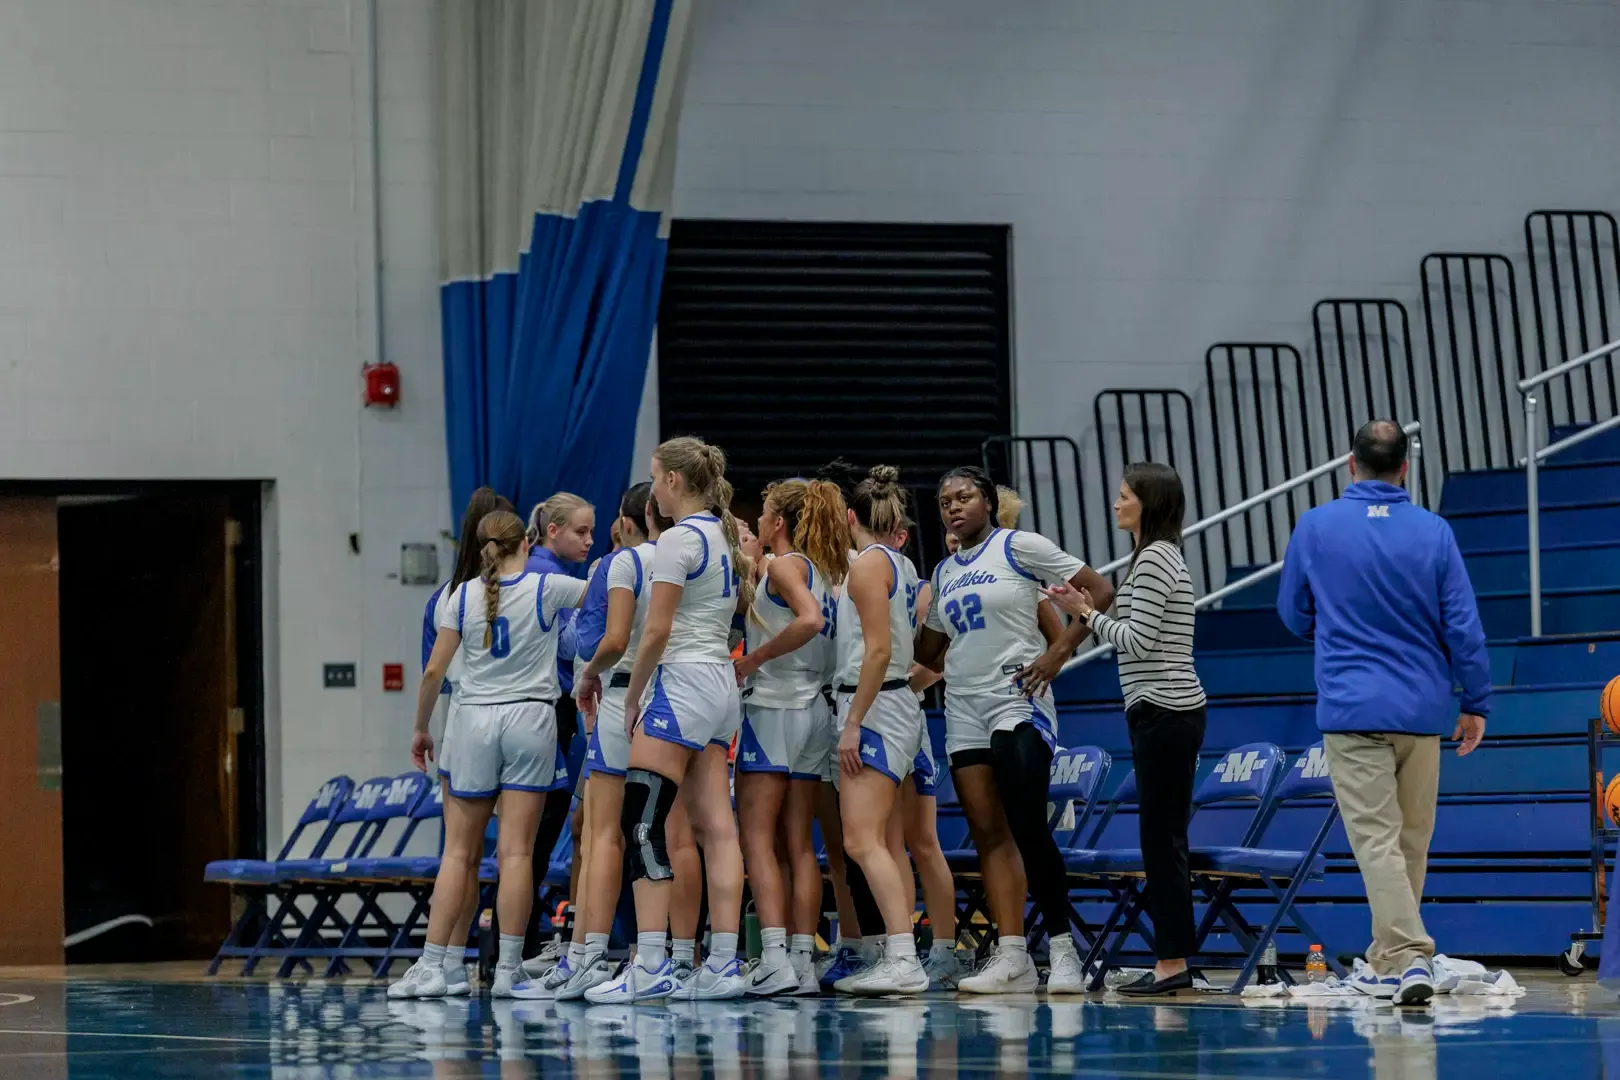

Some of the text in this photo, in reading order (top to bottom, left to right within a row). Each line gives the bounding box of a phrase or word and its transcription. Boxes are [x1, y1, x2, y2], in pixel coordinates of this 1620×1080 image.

[1367, 505, 1391, 517] M
[941, 569, 998, 598] Millikin
[944, 593, 986, 633] 22
[490, 615, 510, 659] 0
[1050, 753, 1087, 785] M
[1220, 751, 1260, 783] M
